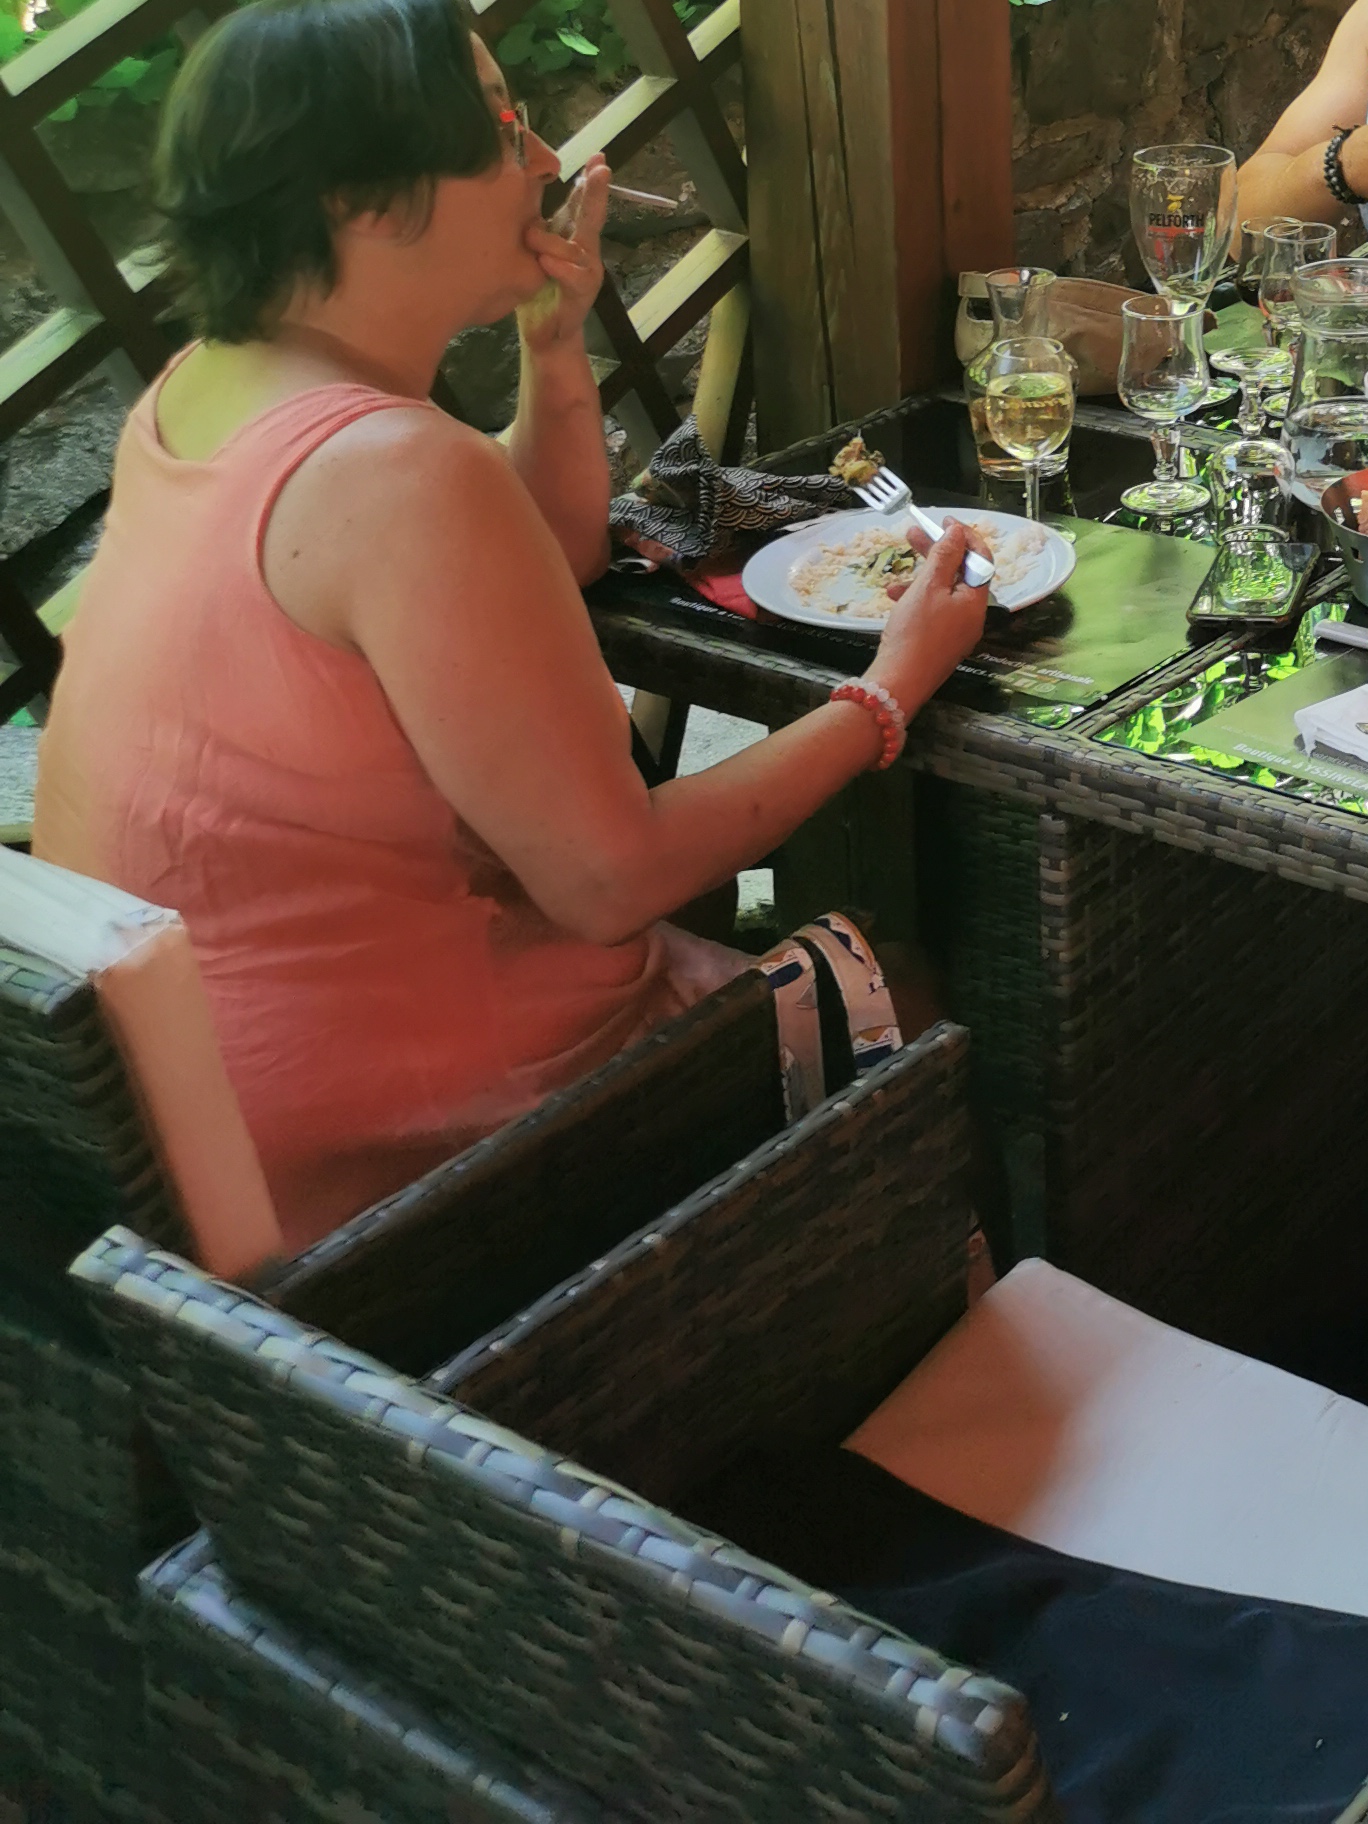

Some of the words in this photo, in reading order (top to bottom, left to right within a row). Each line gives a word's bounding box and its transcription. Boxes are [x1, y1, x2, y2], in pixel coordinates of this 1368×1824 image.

[1149, 213, 1204, 227] PELFORTH
[977, 652, 1037, 671] Production
[1232, 742, 1292, 766] Boutique
